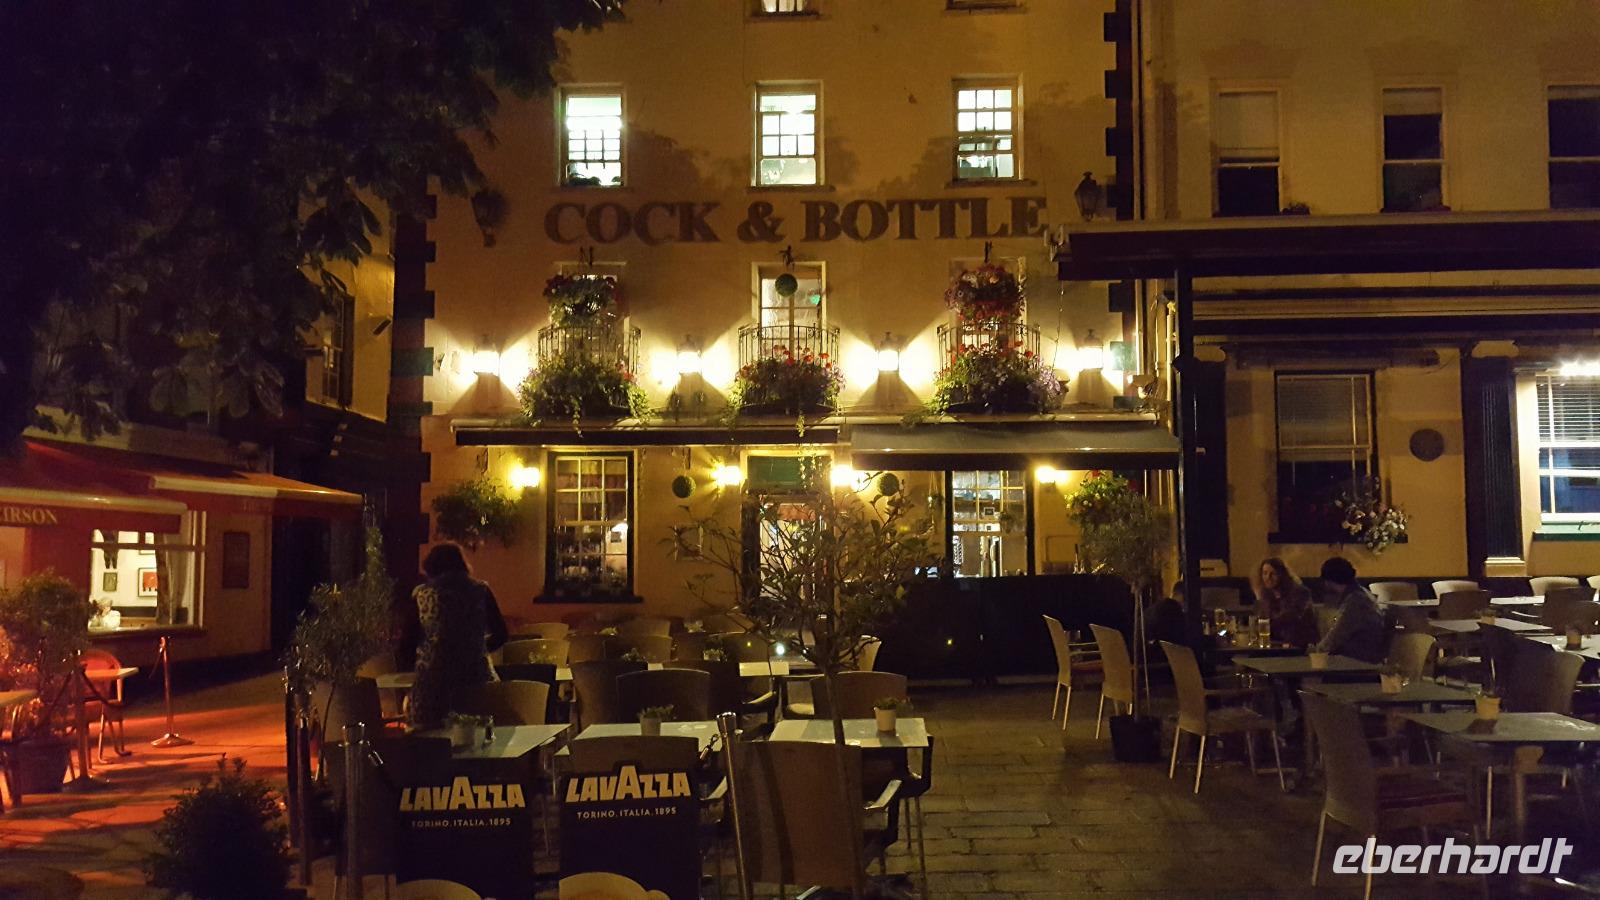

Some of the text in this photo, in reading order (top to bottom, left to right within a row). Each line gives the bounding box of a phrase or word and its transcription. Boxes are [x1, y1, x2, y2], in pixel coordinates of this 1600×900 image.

[543, 197, 1047, 245] COCK & BOTTLE
[0, 506, 58, 525] IRSON
[400, 775, 526, 812] LAVAZZA
[565, 764, 692, 803] LAVAZZA
[654, 806, 677, 816] 1895
